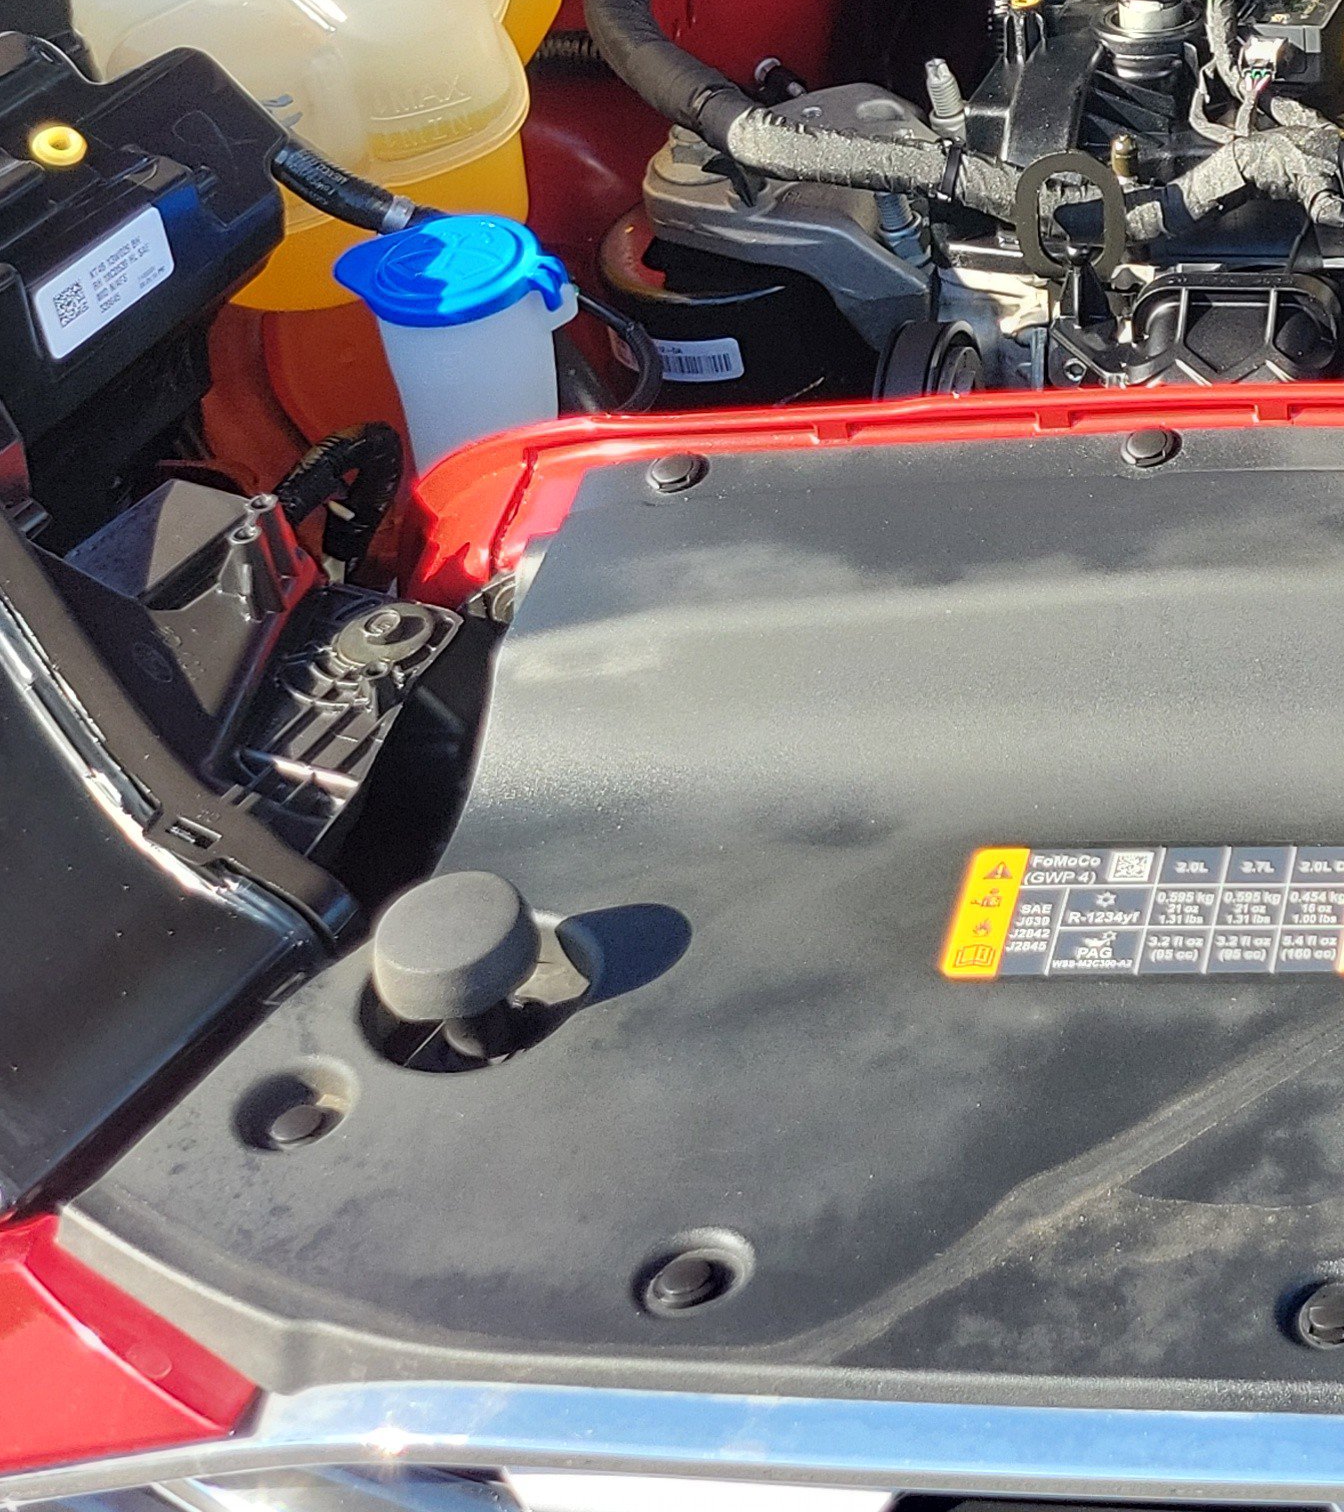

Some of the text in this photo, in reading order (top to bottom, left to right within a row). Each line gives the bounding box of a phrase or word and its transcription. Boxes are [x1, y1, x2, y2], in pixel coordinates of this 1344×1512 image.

[1032, 855, 1101, 868] FoMoCo
[1175, 861, 1209, 874] 2.0L
[1241, 861, 1275, 874] 2.7L
[1299, 861, 1332, 874] 2.0L
[1024, 871, 1097, 885] (GWP 4)
[1197, 891, 1215, 906] kg
[1263, 891, 1282, 906] kg
[1289, 891, 1328, 904] 0.454
[1020, 904, 1052, 914] SAE
[1166, 904, 1199, 914] 21 oz
[1233, 904, 1267, 914] 21 oz
[1317, 905, 1332, 914] oz
[1068, 910, 1141, 925] R-1234yf
[1159, 914, 1204, 924] 1.31 lbs
[1226, 914, 1271, 924] 1.31 lbs
[1293, 914, 1337, 924] 1.00 lbs
[1149, 935, 1203, 947] 3.2 fl oz
[1215, 935, 1271, 947] 3.2 fl oz
[1307, 935, 1317, 947] fl
[1320, 937, 1337, 947] oz
[1077, 946, 1112, 959] PAG
[1176, 948, 1198, 962] cc)
[1244, 948, 1266, 962] cc)
[1313, 948, 1337, 962] cc)
